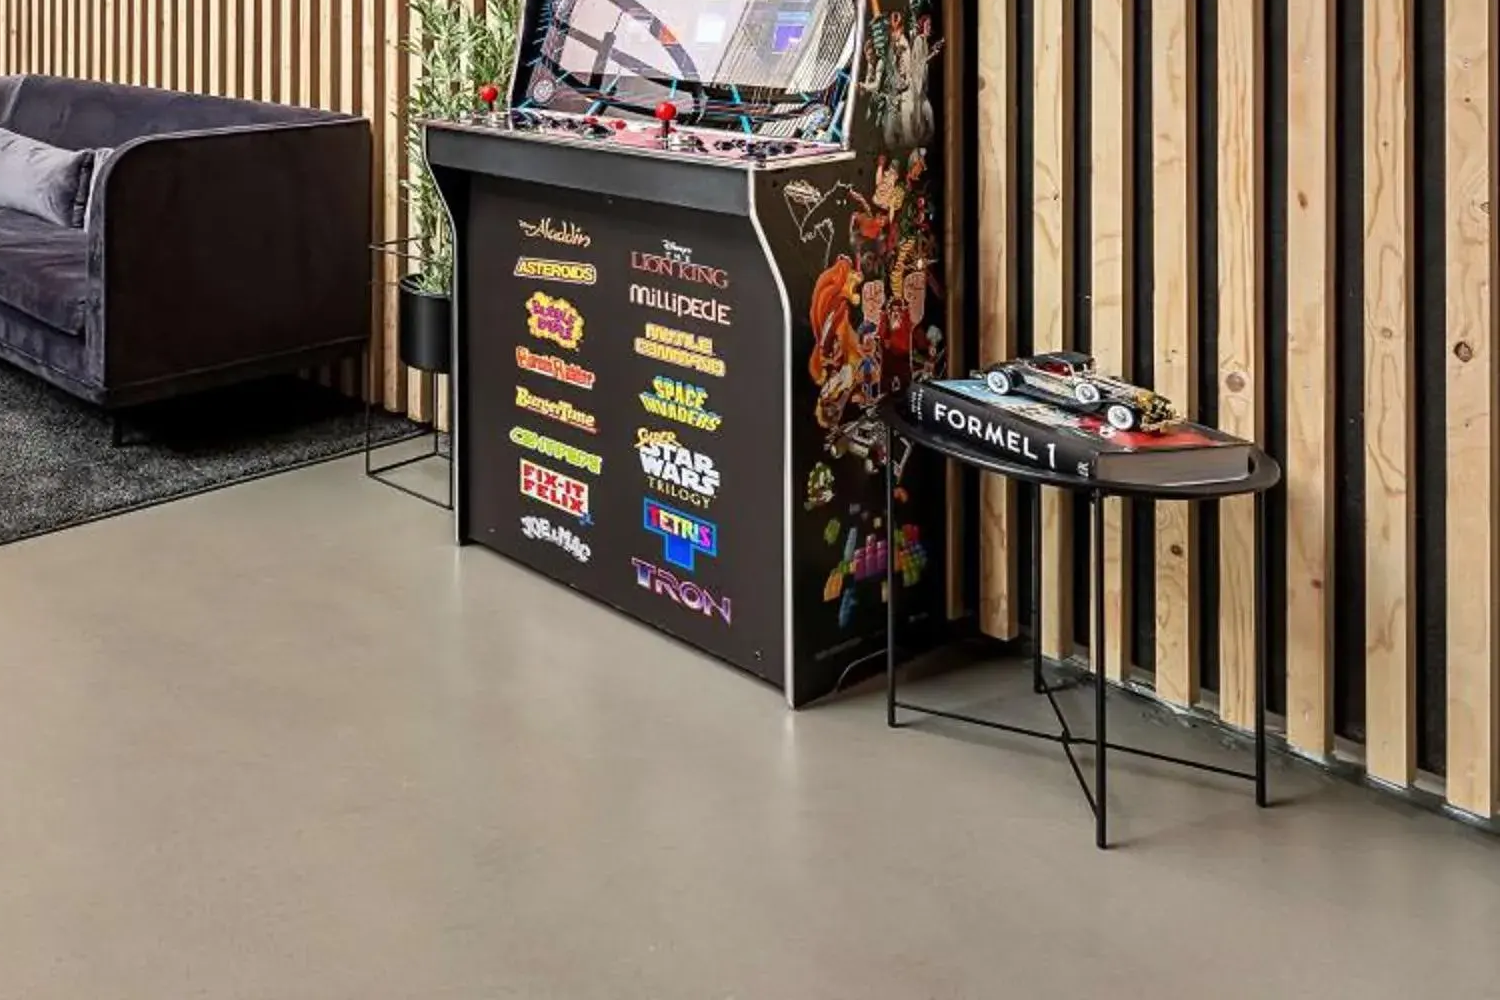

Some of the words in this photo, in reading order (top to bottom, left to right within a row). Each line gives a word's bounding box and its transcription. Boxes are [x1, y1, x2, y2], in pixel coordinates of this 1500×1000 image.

[525, 217, 591, 248] Aladdin
[519, 260, 594, 281] ASTEROIDS
[631, 251, 674, 277] LION
[678, 262, 729, 289] KING
[653, 375, 709, 408] SPACE
[639, 391, 723, 431] INVADERS
[934, 401, 1039, 460] FORMEL
[1047, 442, 1056, 469] 1
[640, 443, 720, 479] STAR
[640, 453, 720, 497] WARS
[523, 463, 585, 498] FIX-IT
[523, 478, 584, 513] FELIX
[647, 476, 711, 509] TRILOGY
[648, 503, 711, 549] TETRIS
[631, 557, 732, 626] TRON
